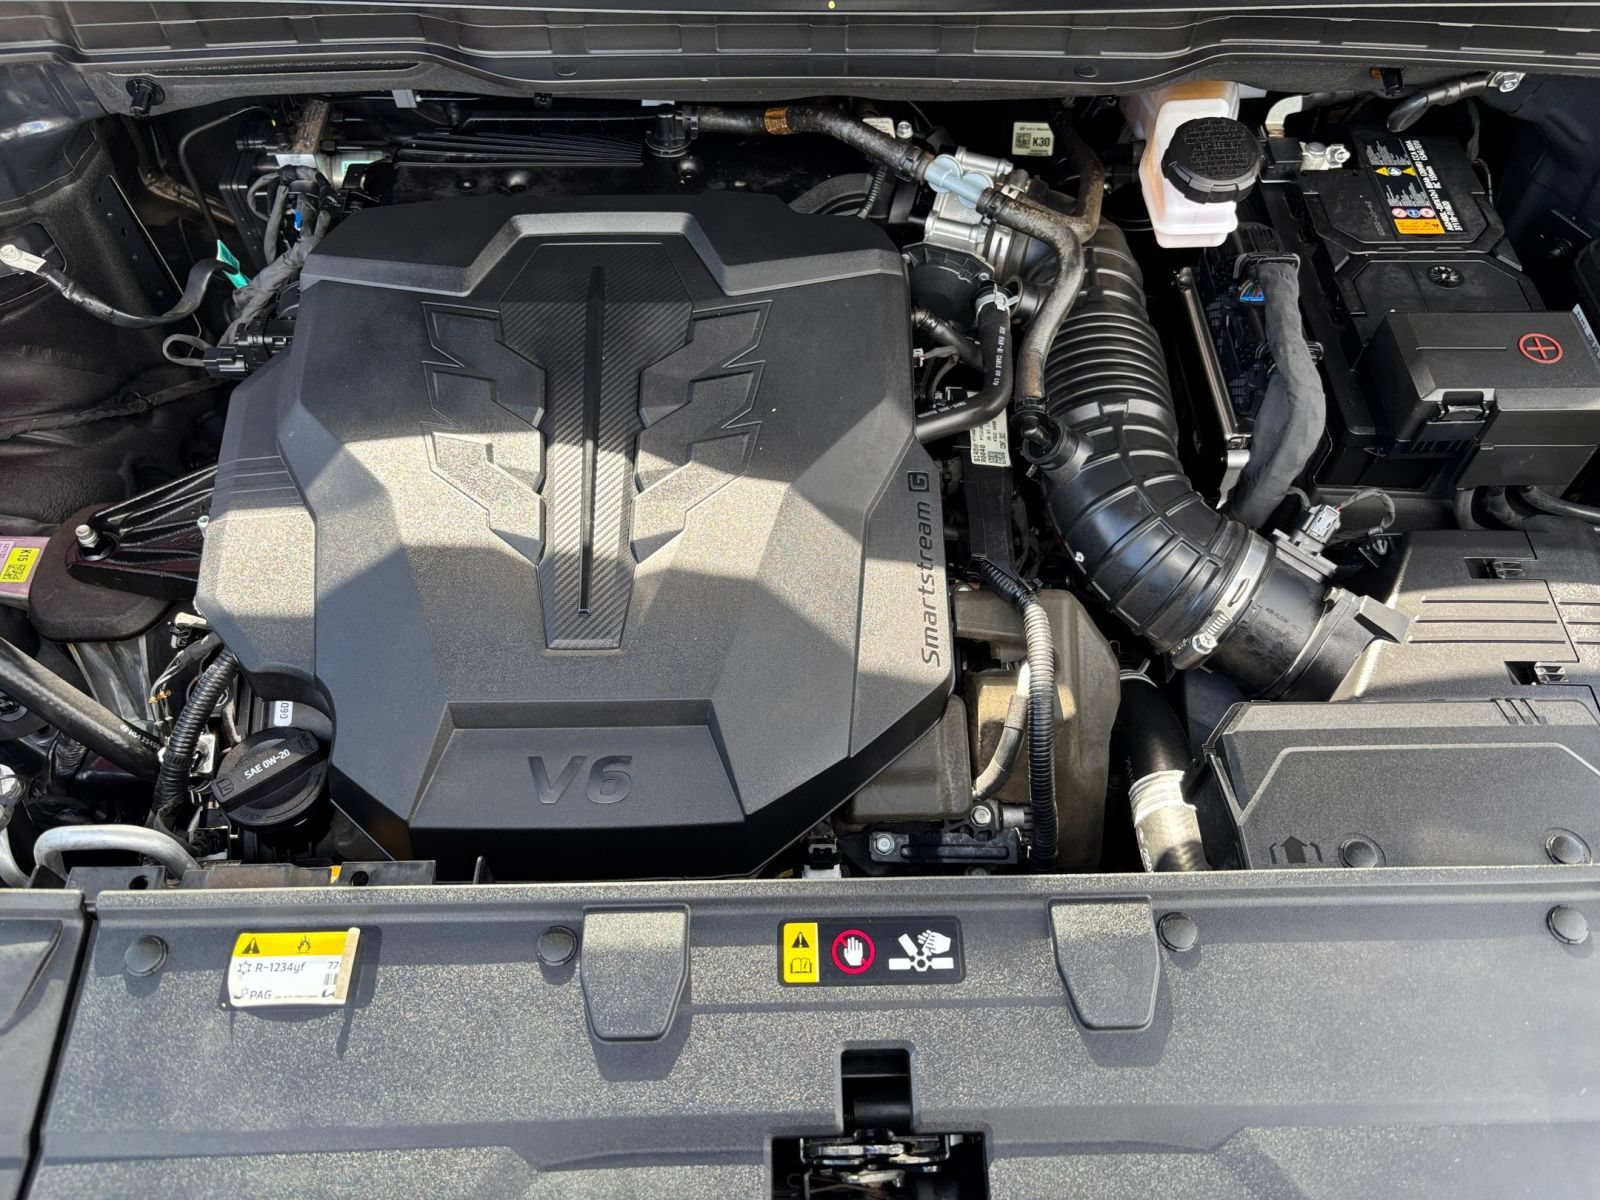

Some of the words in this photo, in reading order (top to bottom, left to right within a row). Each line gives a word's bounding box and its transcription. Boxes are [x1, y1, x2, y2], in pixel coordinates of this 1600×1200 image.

[1032, 136, 1050, 147] K30
[16, 549, 32, 561] K15
[915, 501, 941, 667] Smartstream
[1274, 613, 1289, 623] FLOW
[244, 763, 263, 780] SAE
[262, 748, 291, 769] 0W-20
[527, 754, 633, 805] V6
[255, 961, 307, 975] R-1234yf
[249, 990, 272, 1000] PAG
